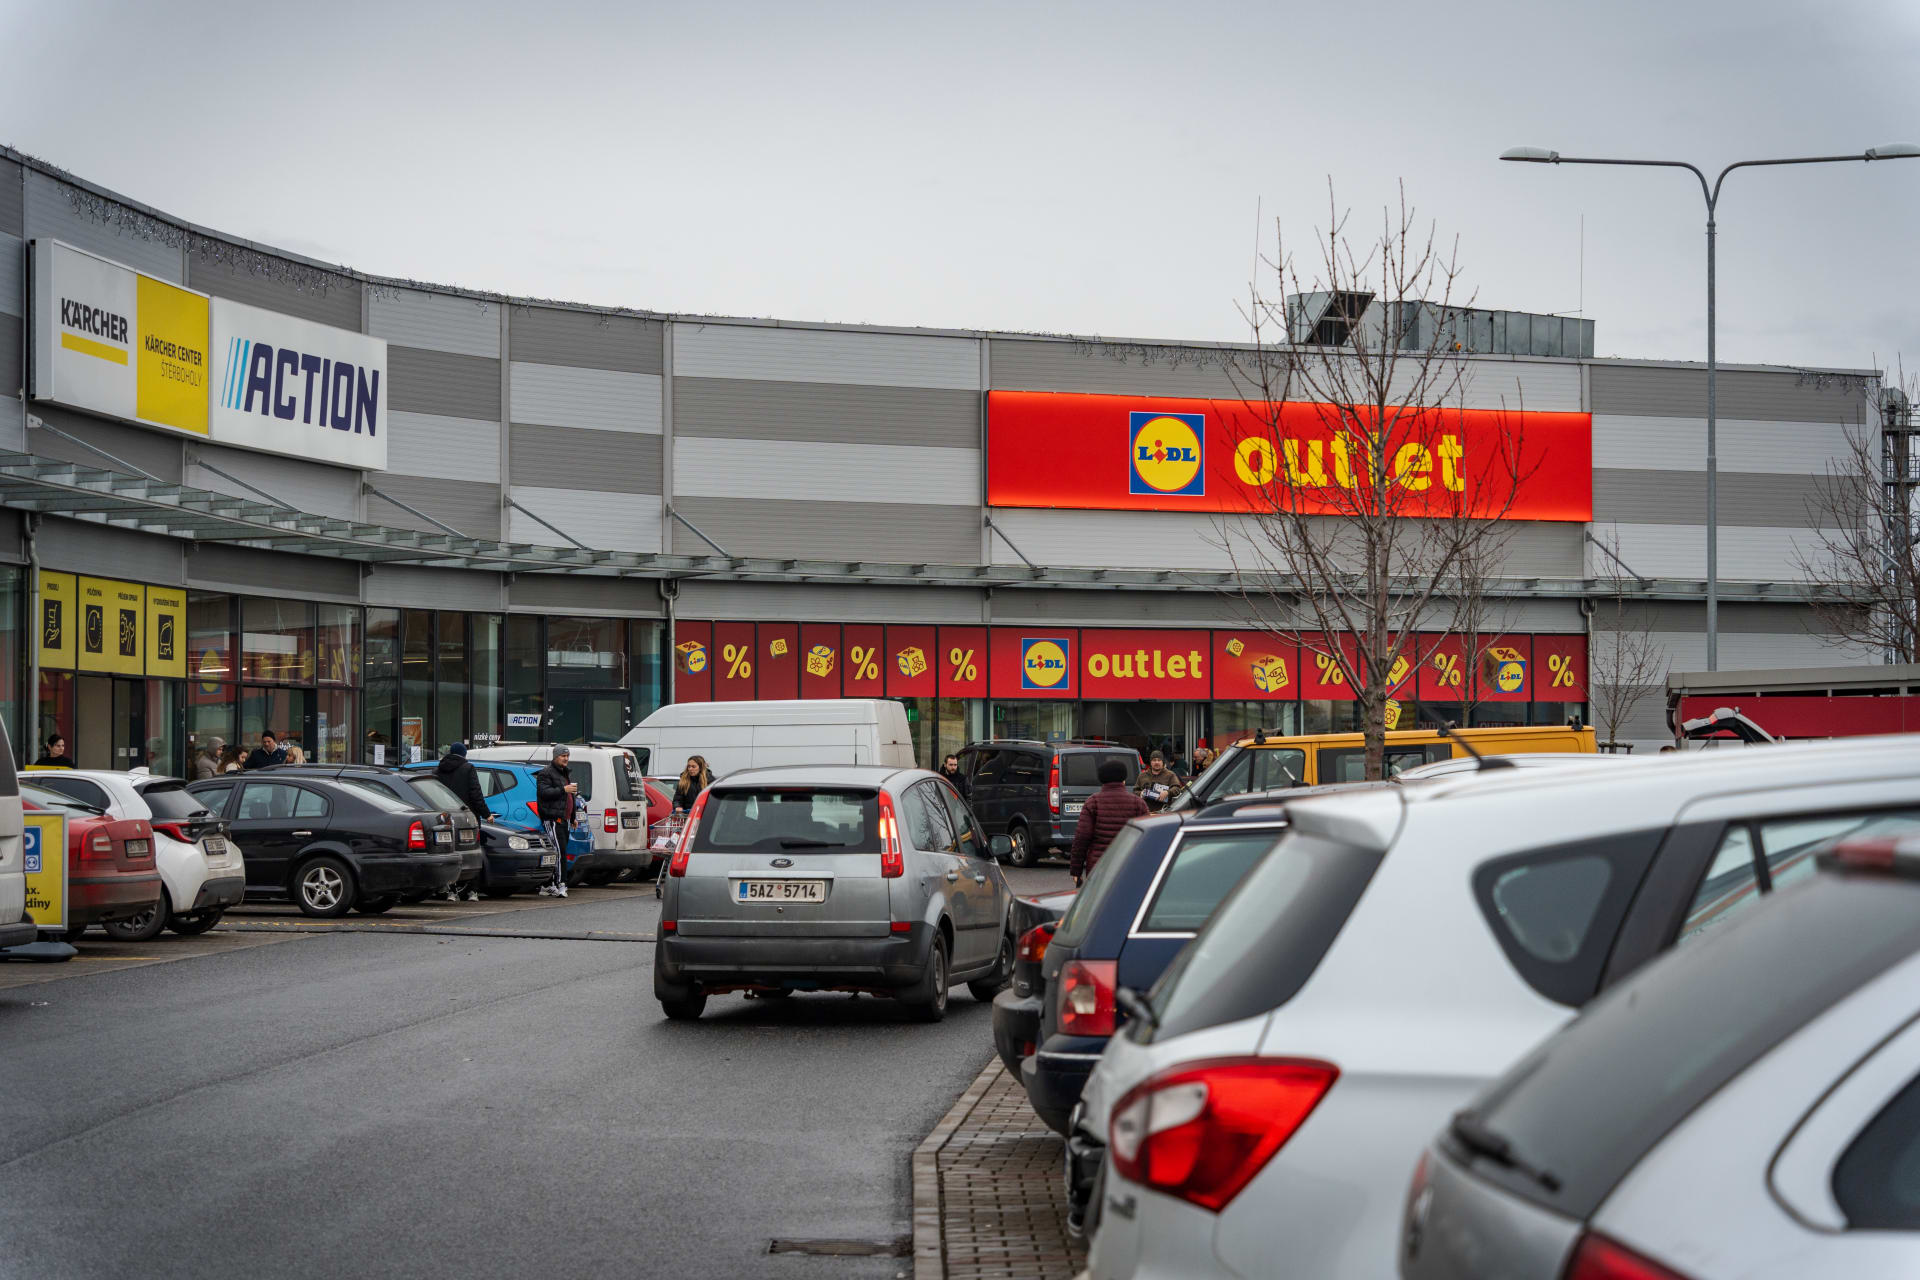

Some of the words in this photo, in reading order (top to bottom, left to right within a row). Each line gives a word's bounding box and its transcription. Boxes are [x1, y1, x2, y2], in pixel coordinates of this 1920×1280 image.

[61, 297, 128, 344] KÄRCHER
[145, 334, 177, 359] KÄRCHER
[178, 345, 202, 367] CENTER
[243, 342, 380, 437] ACTION
[1234, 430, 1466, 492] outlet
[723, 644, 751, 679] %
[851, 645, 879, 680] %
[950, 647, 977, 681] %
[1088, 649, 1202, 679] outlet
[1434, 652, 1461, 687] %
[1548, 654, 1575, 687] %
[512, 716, 539, 725] ACTION
[750, 884, 774, 898] 5AZ
[784, 884, 816, 898] 5714
